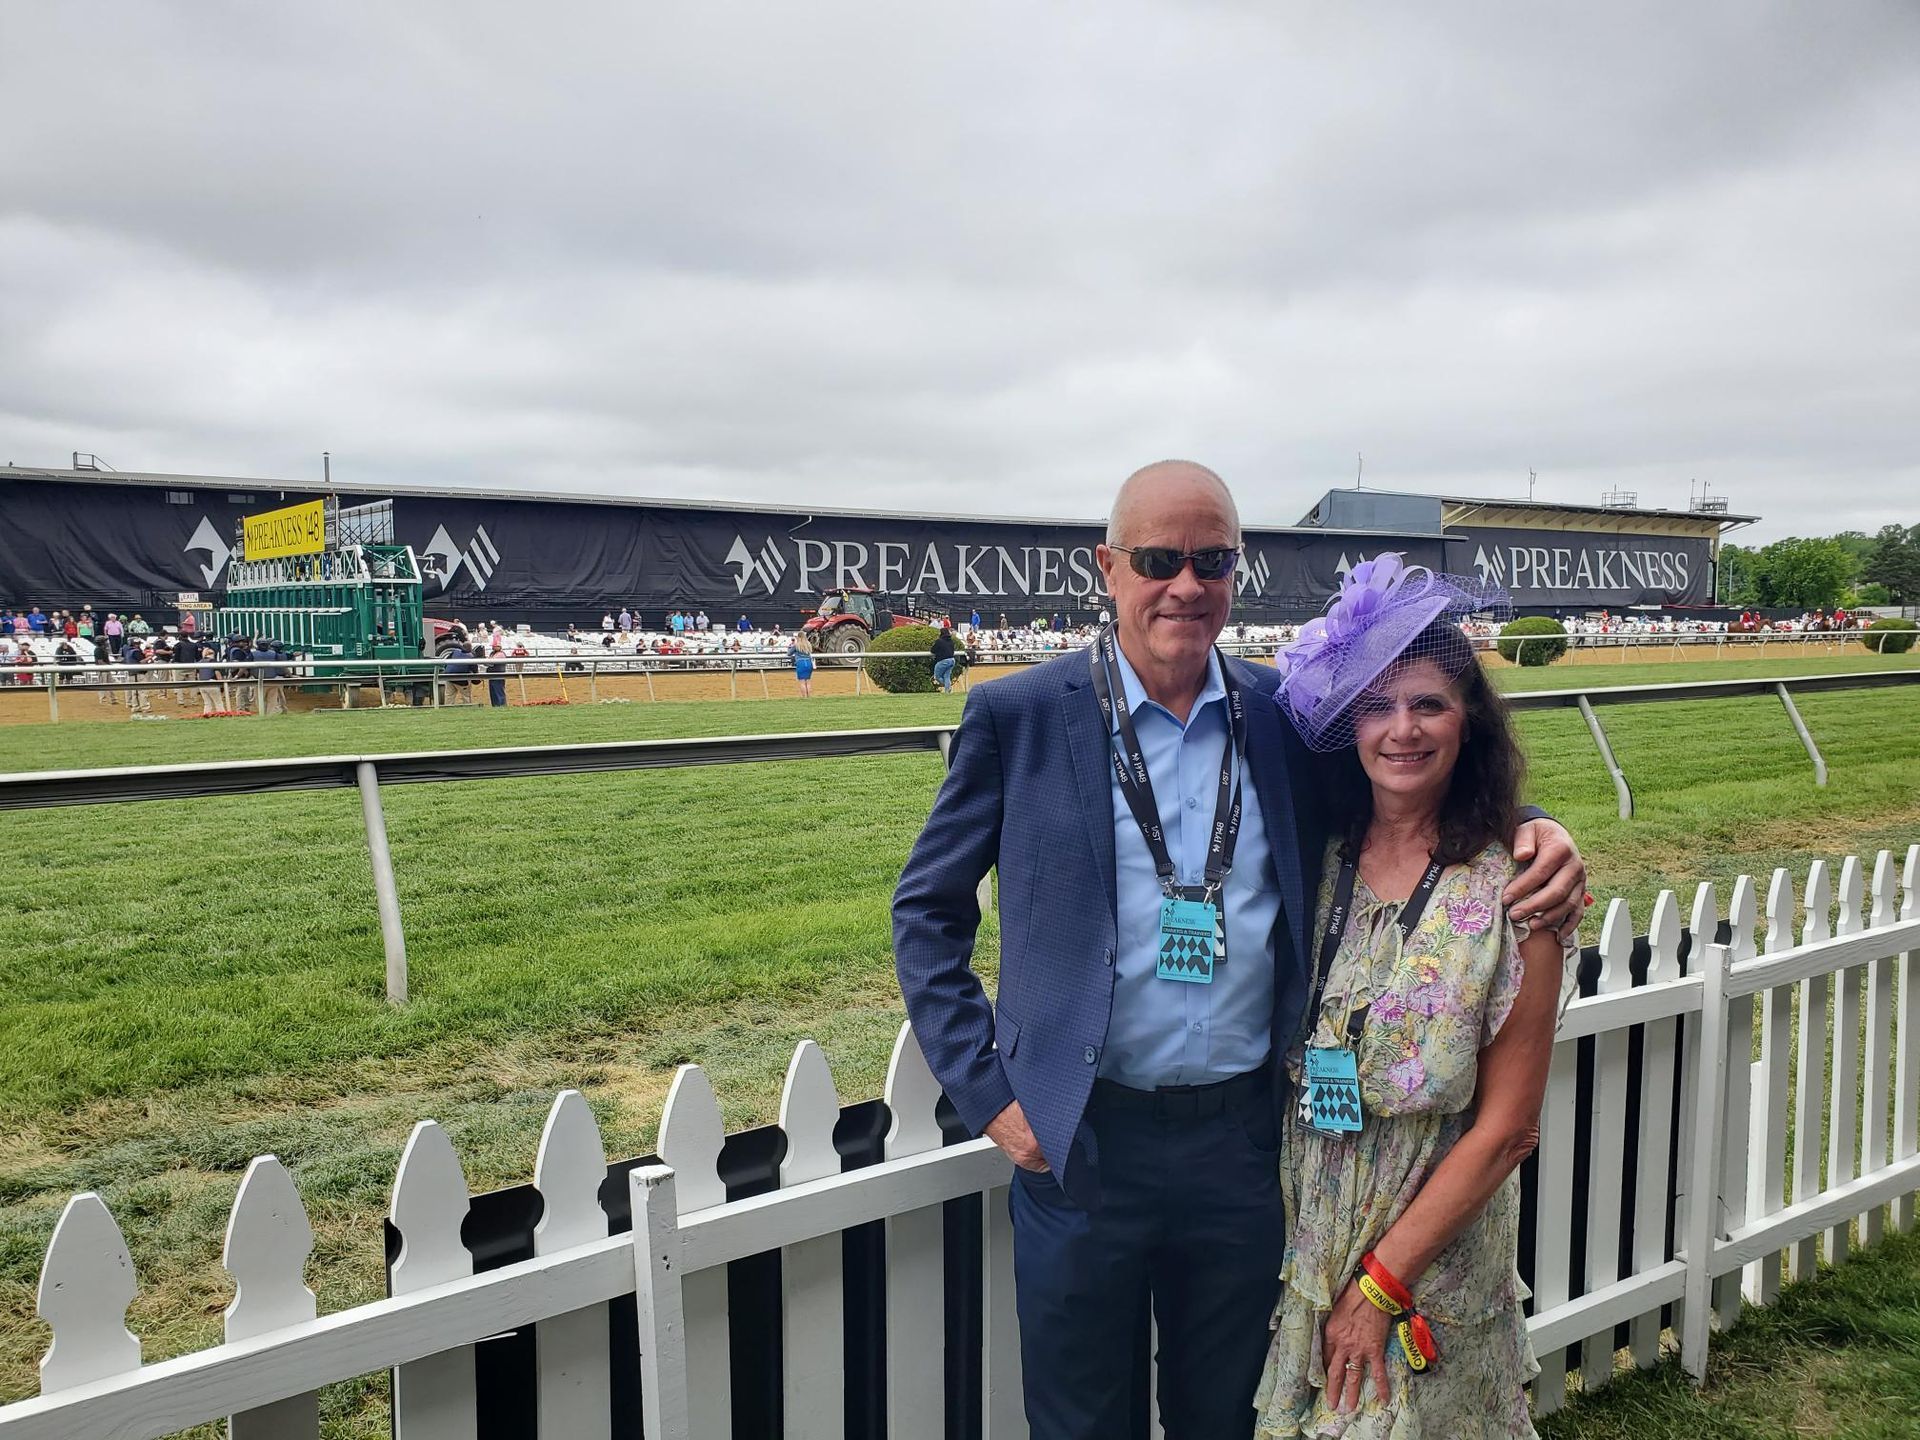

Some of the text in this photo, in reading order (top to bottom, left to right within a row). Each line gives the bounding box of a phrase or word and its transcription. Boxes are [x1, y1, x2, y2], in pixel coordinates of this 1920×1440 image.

[254, 511, 320, 551] PREAKNESS 148
[1508, 546, 1689, 591] PREAKNESS
[1401, 1322, 1423, 1367] OWNERS
